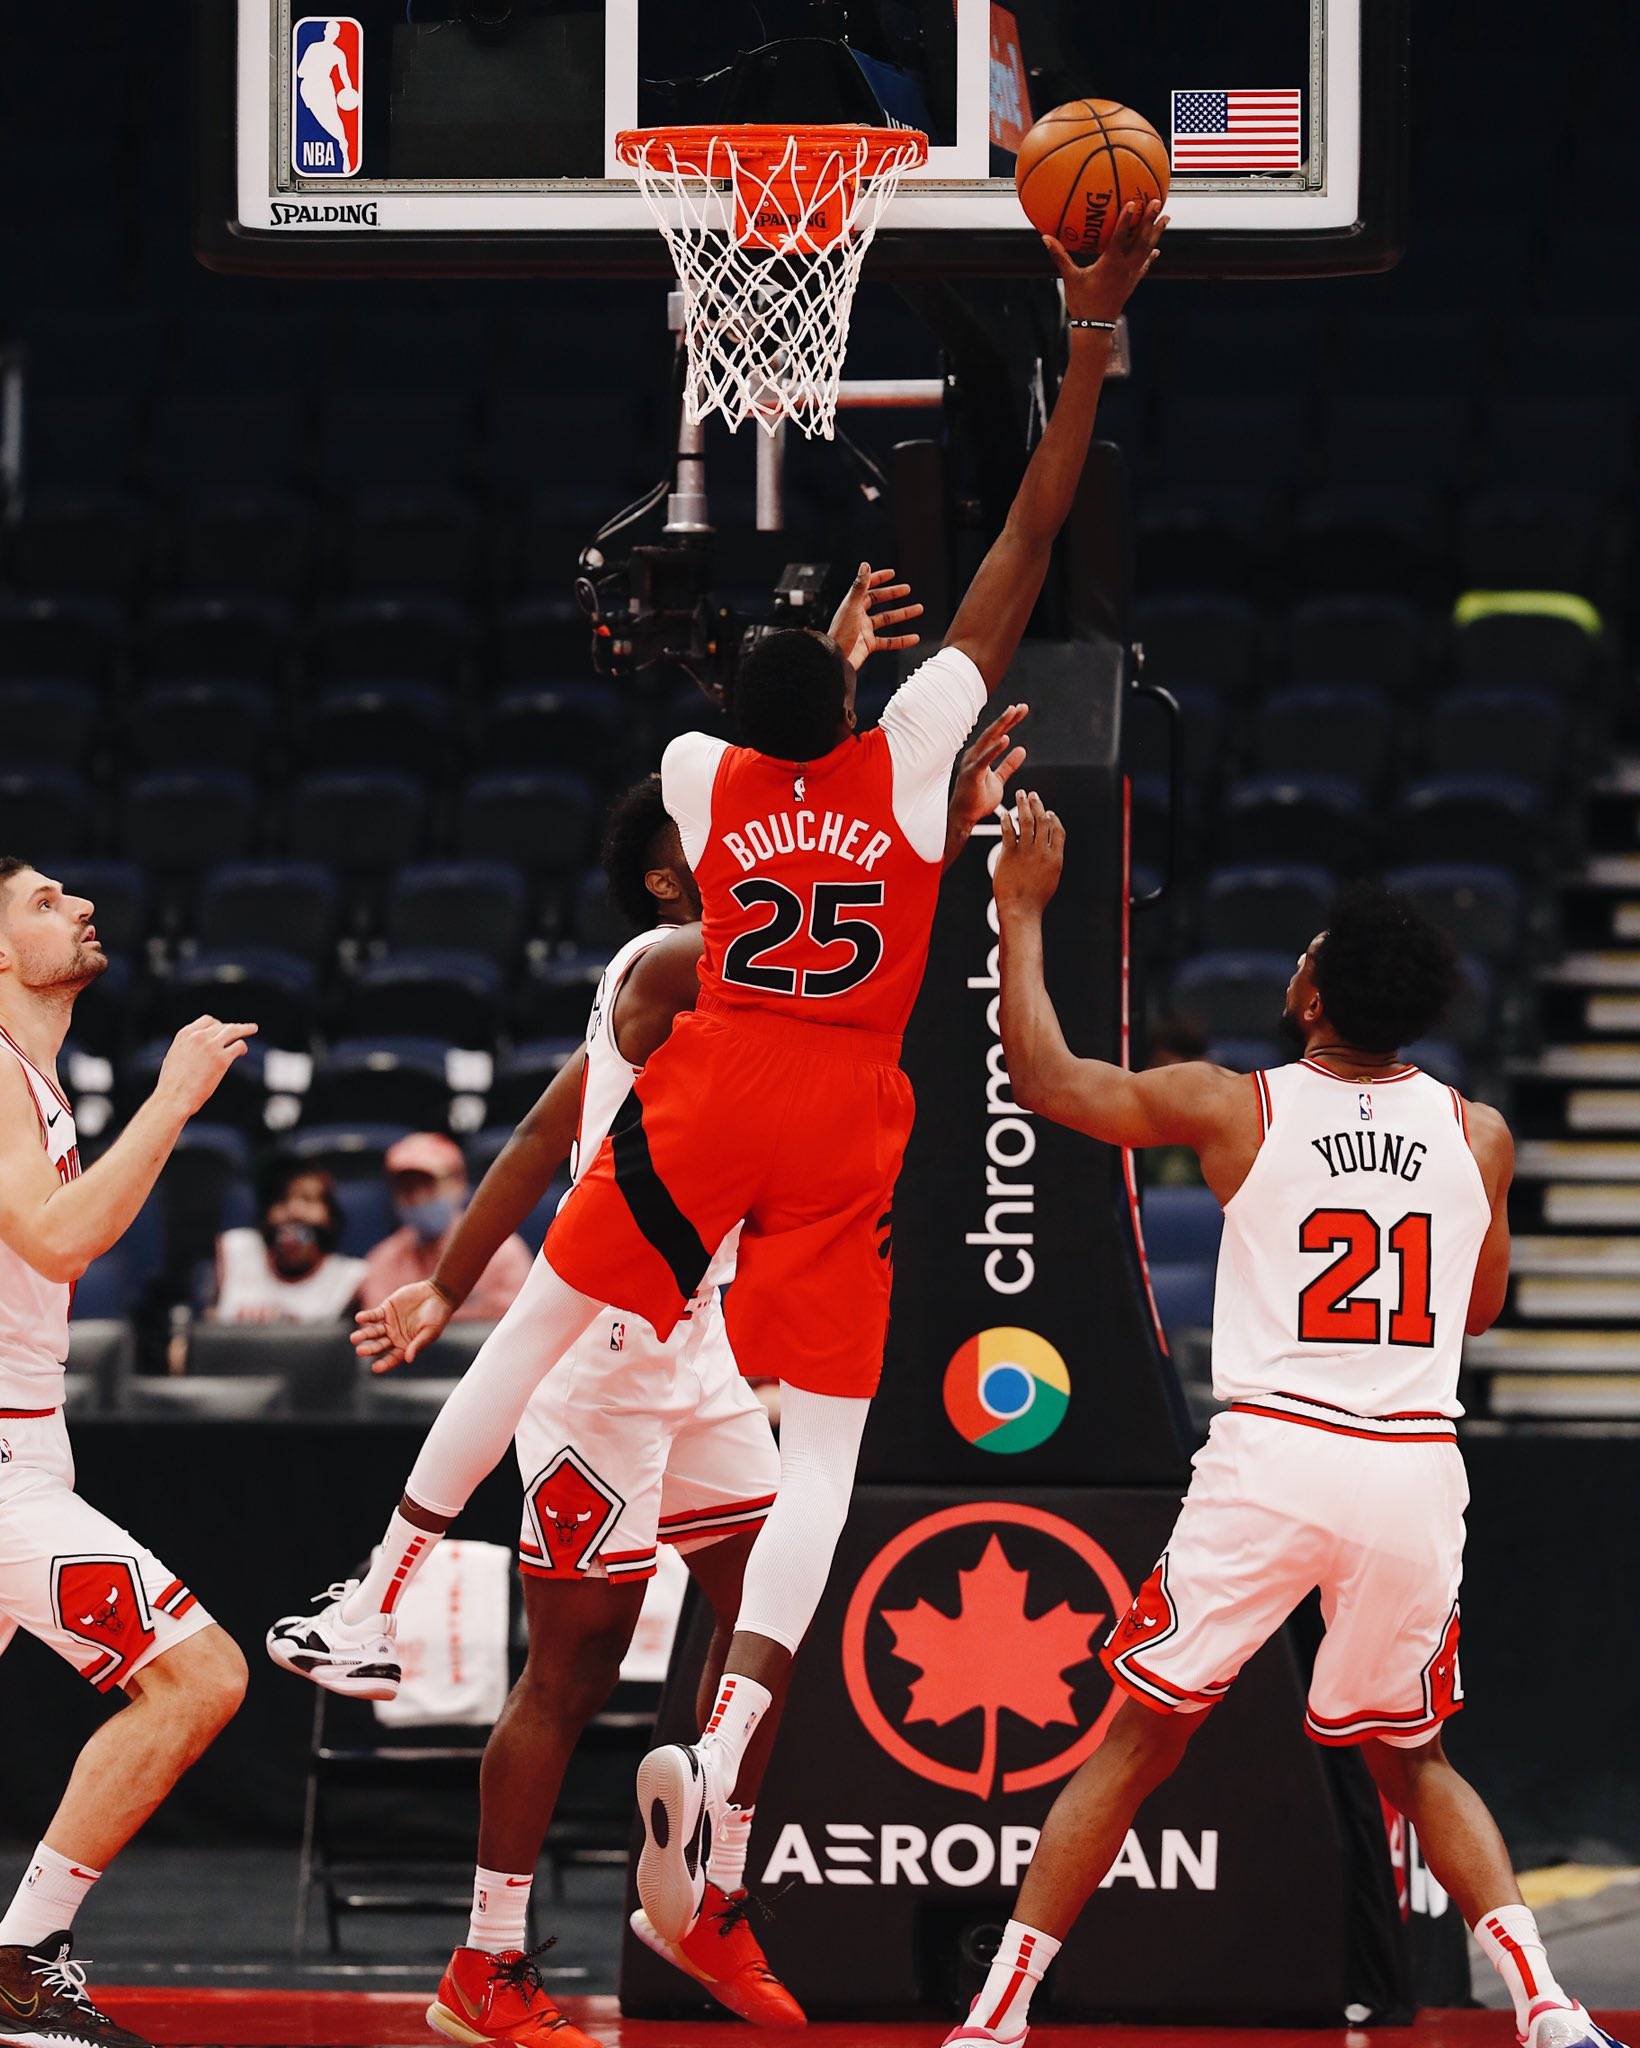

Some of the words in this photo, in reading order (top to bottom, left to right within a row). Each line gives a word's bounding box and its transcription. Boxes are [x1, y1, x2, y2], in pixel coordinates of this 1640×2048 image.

[303, 141, 336, 166] NBA
[270, 202, 378, 226] SPALDING
[721, 810, 892, 872] BOUCHER
[722, 877, 885, 998] 25
[1311, 1131, 1428, 1182] YOUNG
[1298, 1208, 1436, 1348] 21
[761, 1823, 1219, 1891] AEROPAN
